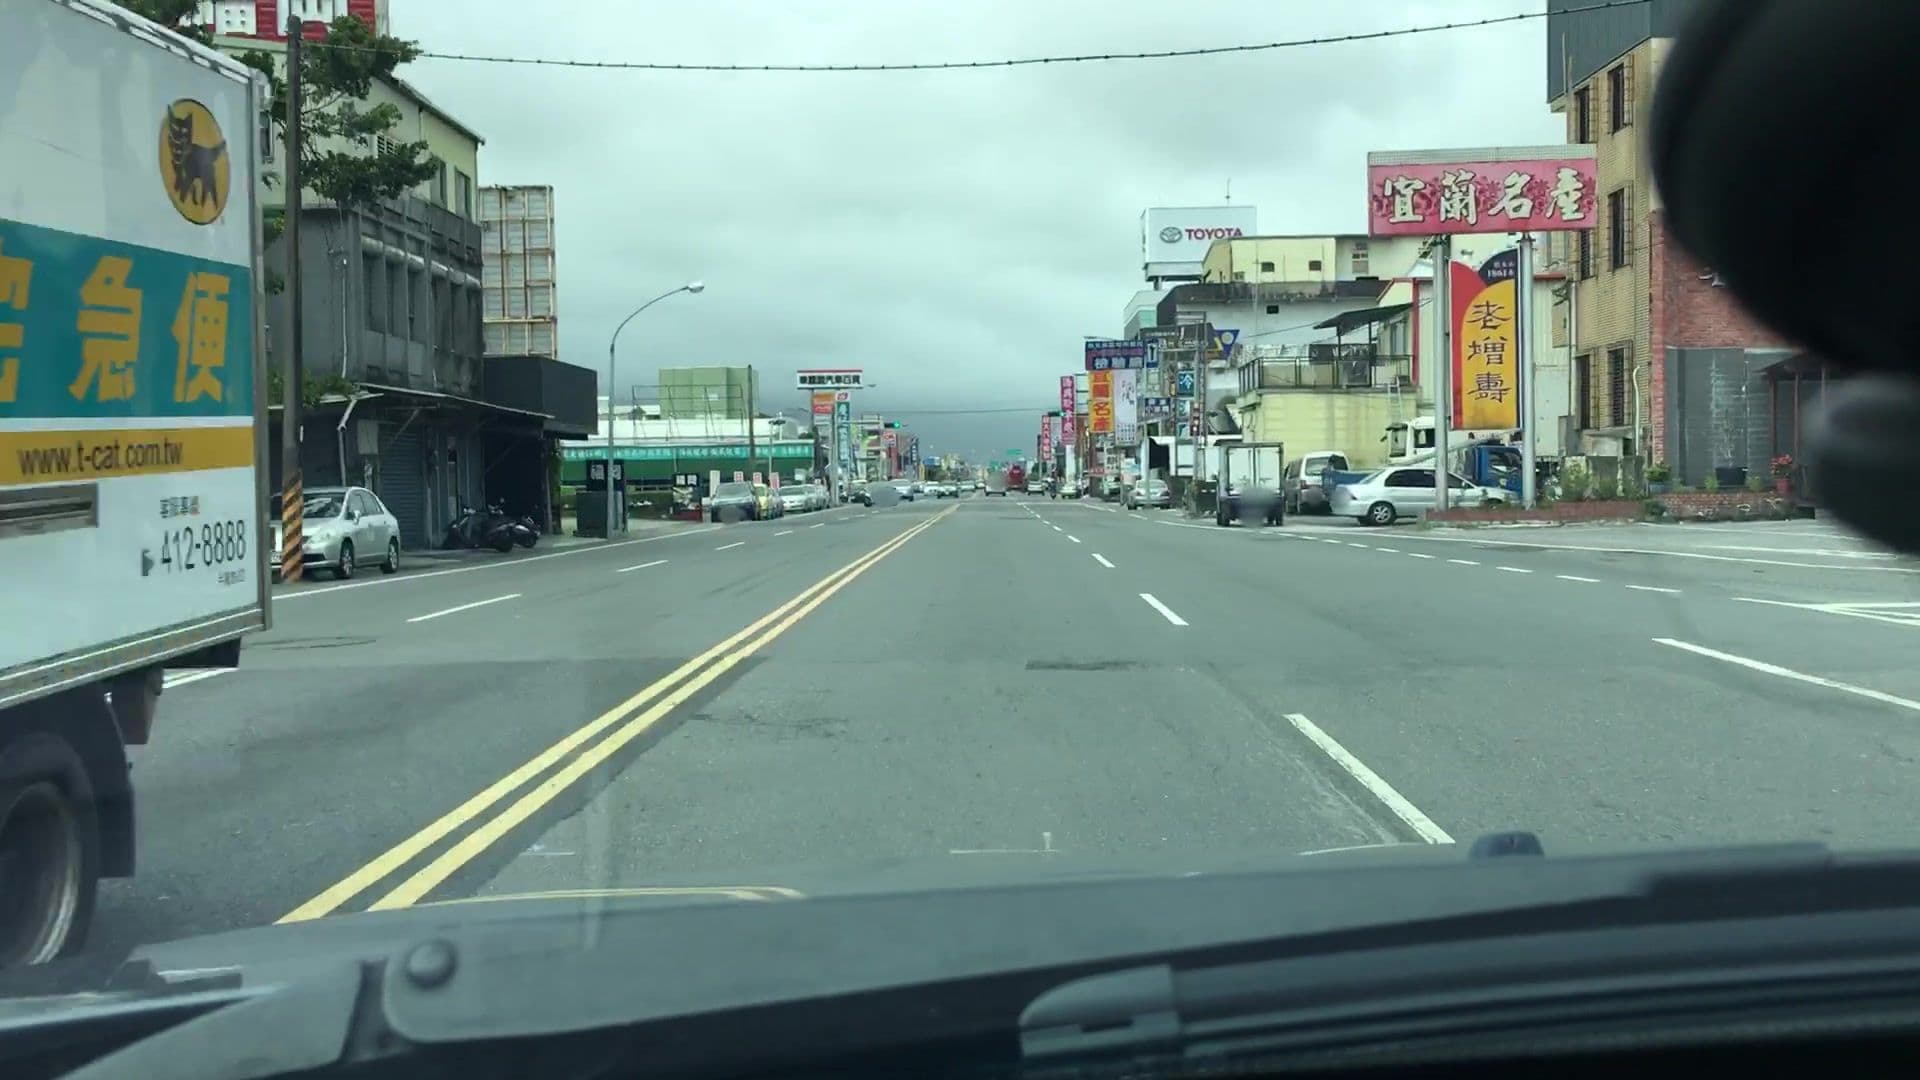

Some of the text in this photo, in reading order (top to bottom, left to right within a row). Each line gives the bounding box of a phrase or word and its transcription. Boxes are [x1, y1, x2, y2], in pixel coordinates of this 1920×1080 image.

[1384, 167, 1586, 225] 宜蘭名產
[1185, 228, 1243, 240] TOYOTA
[1466, 300, 1513, 404] 老增壽
[18, 440, 183, 476] www.t-cat.com.tw
[161, 520, 247, 575] 412-8888
